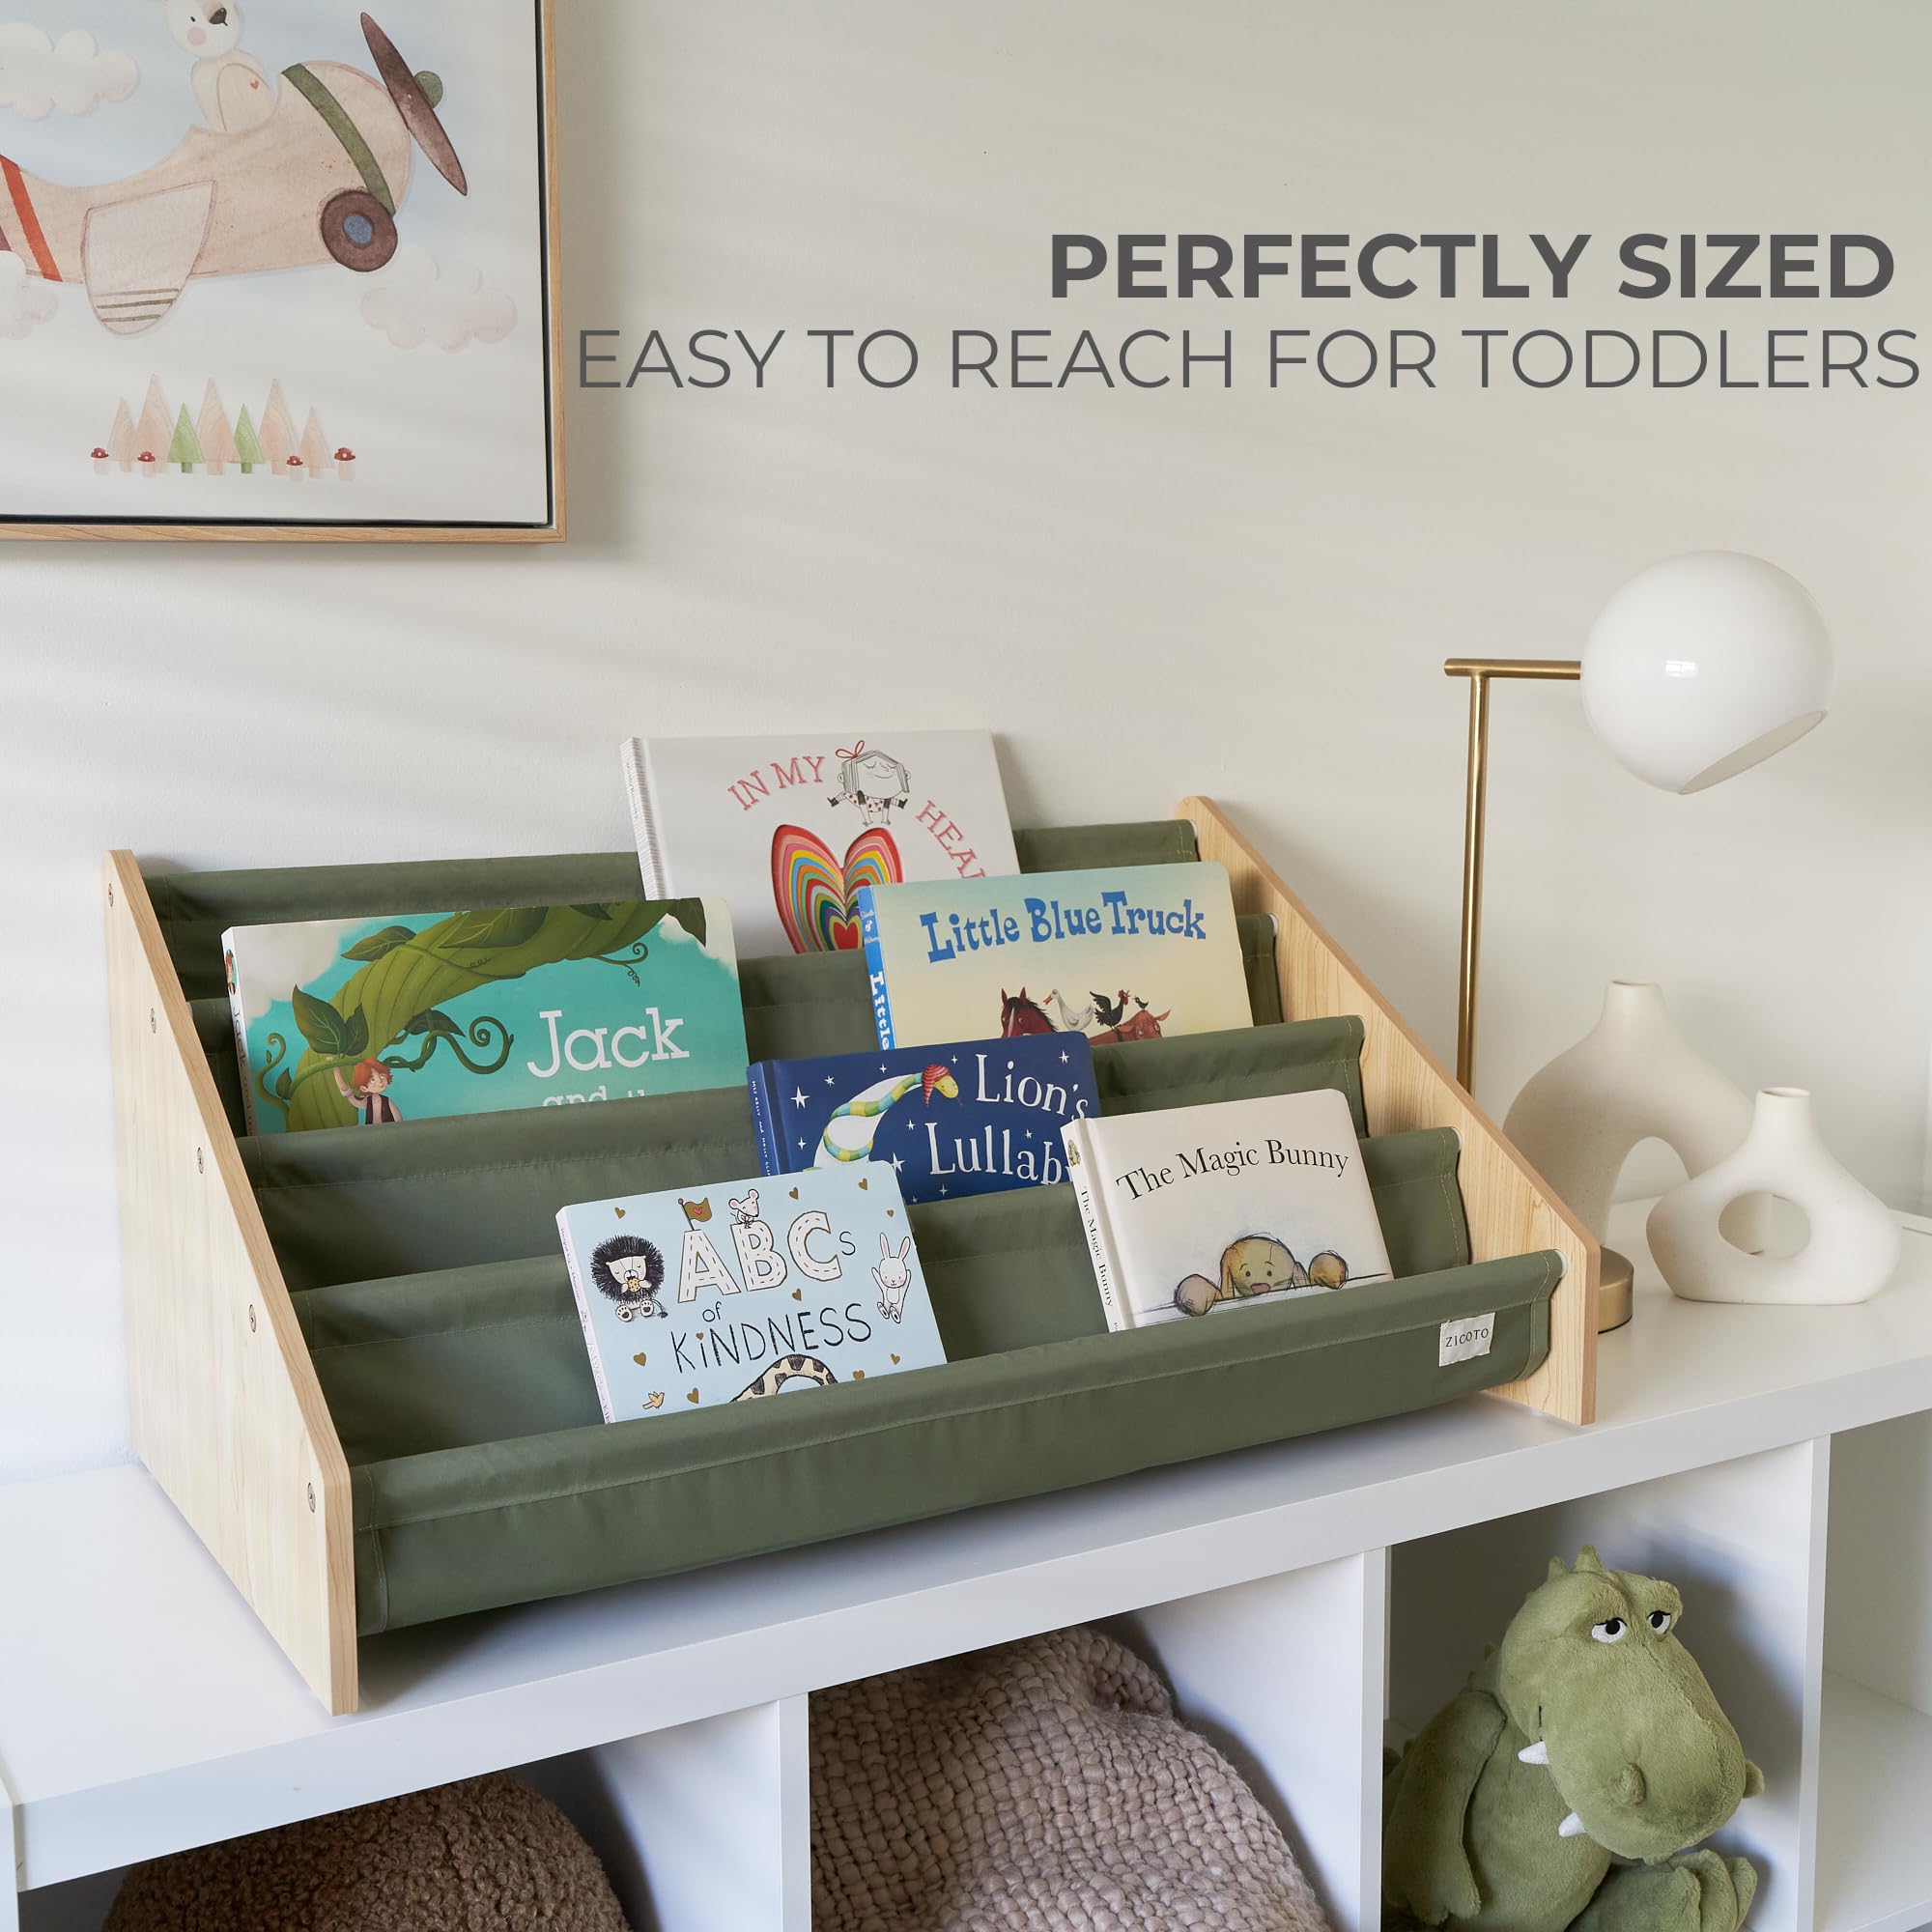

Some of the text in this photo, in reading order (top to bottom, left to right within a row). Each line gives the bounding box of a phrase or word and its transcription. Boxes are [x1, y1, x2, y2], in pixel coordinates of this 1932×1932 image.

[726, 770, 770, 811] IN
[770, 755, 826, 789] MY
[919, 890, 1207, 964] Little Blue Truck
[526, 1006, 691, 1078] Jack
[869, 970, 891, 1051] Little
[975, 1053, 1090, 1121] Lion's
[923, 1122, 1074, 1186] Lullab
[1115, 1138, 1350, 1202] The Magic Bunny
[676, 1209, 858, 1304] ABCs
[1080, 1185, 1114, 1308] The Magic Bunny
[701, 1300, 724, 1324] of
[1445, 1327, 1490, 1348] ZICOTO
